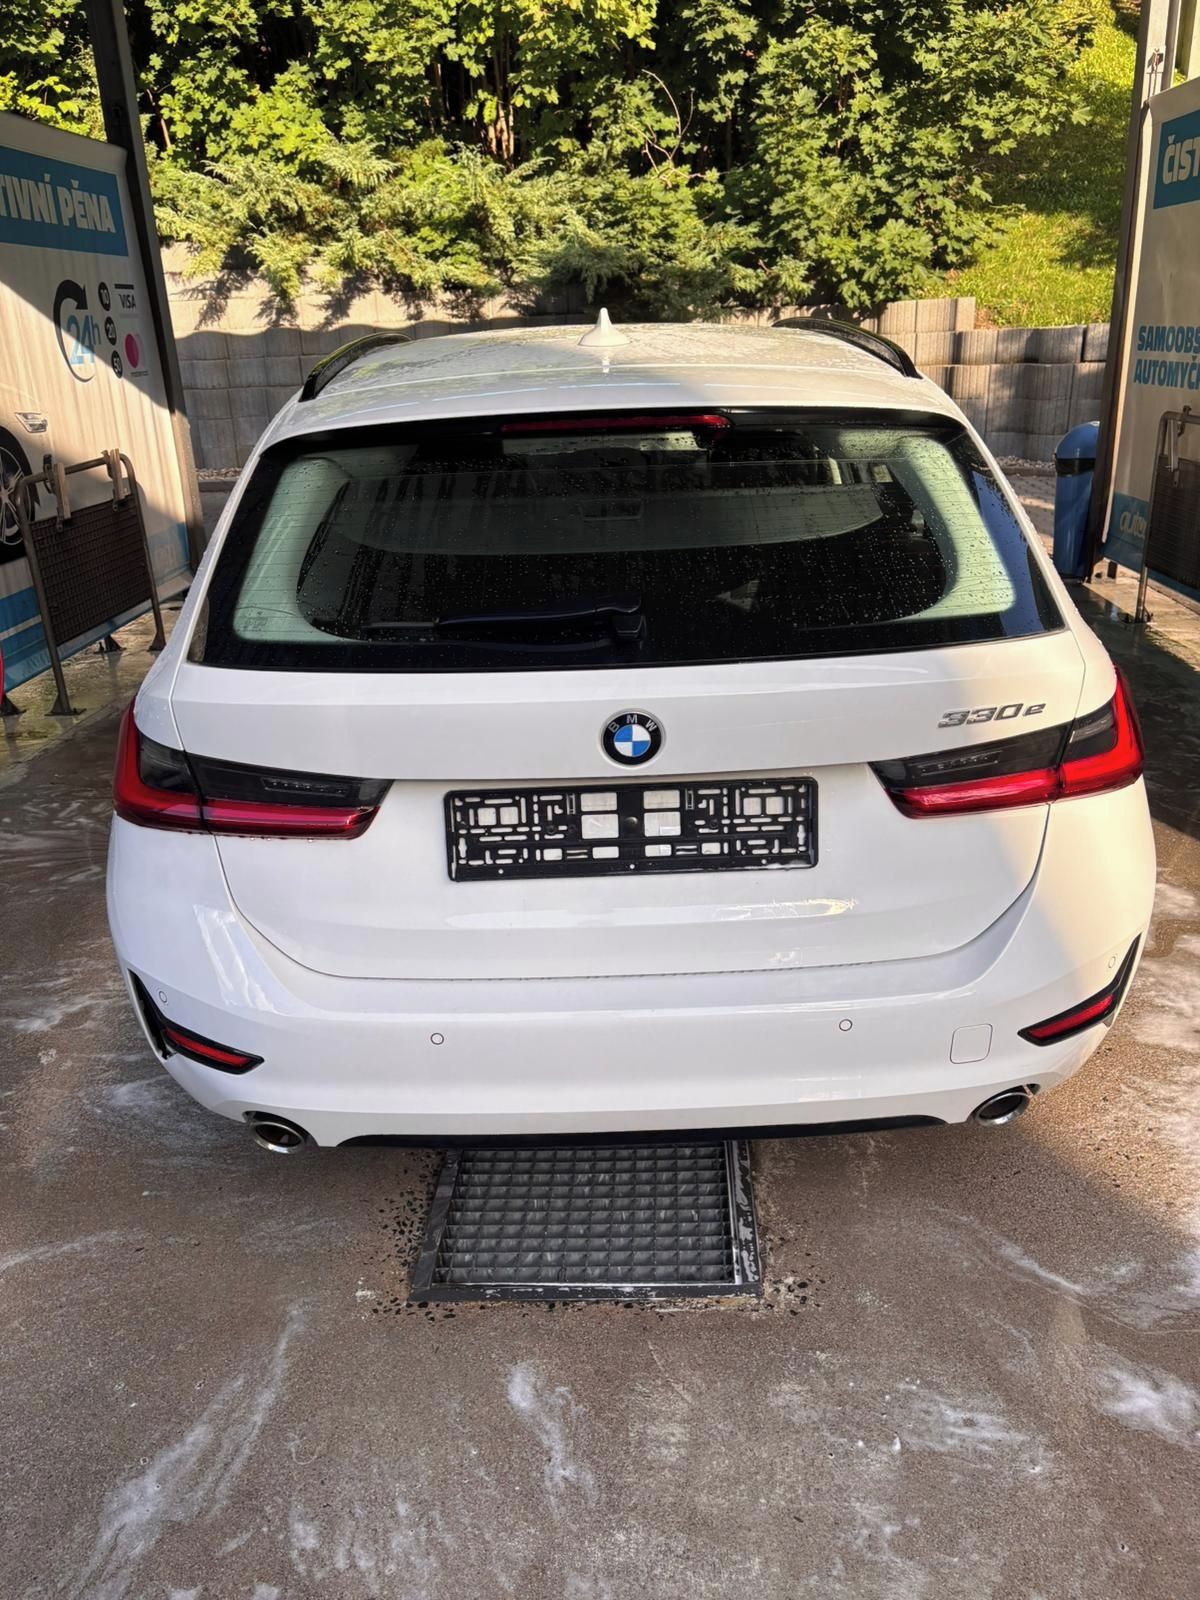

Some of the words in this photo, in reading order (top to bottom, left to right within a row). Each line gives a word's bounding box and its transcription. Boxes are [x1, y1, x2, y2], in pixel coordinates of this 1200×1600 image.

[56, 179, 116, 233] PĚNA
[118, 294, 136, 308] VISA
[66, 314, 101, 366] 24h
[608, 714, 657, 733] BMW
[937, 703, 1046, 728] 330e
